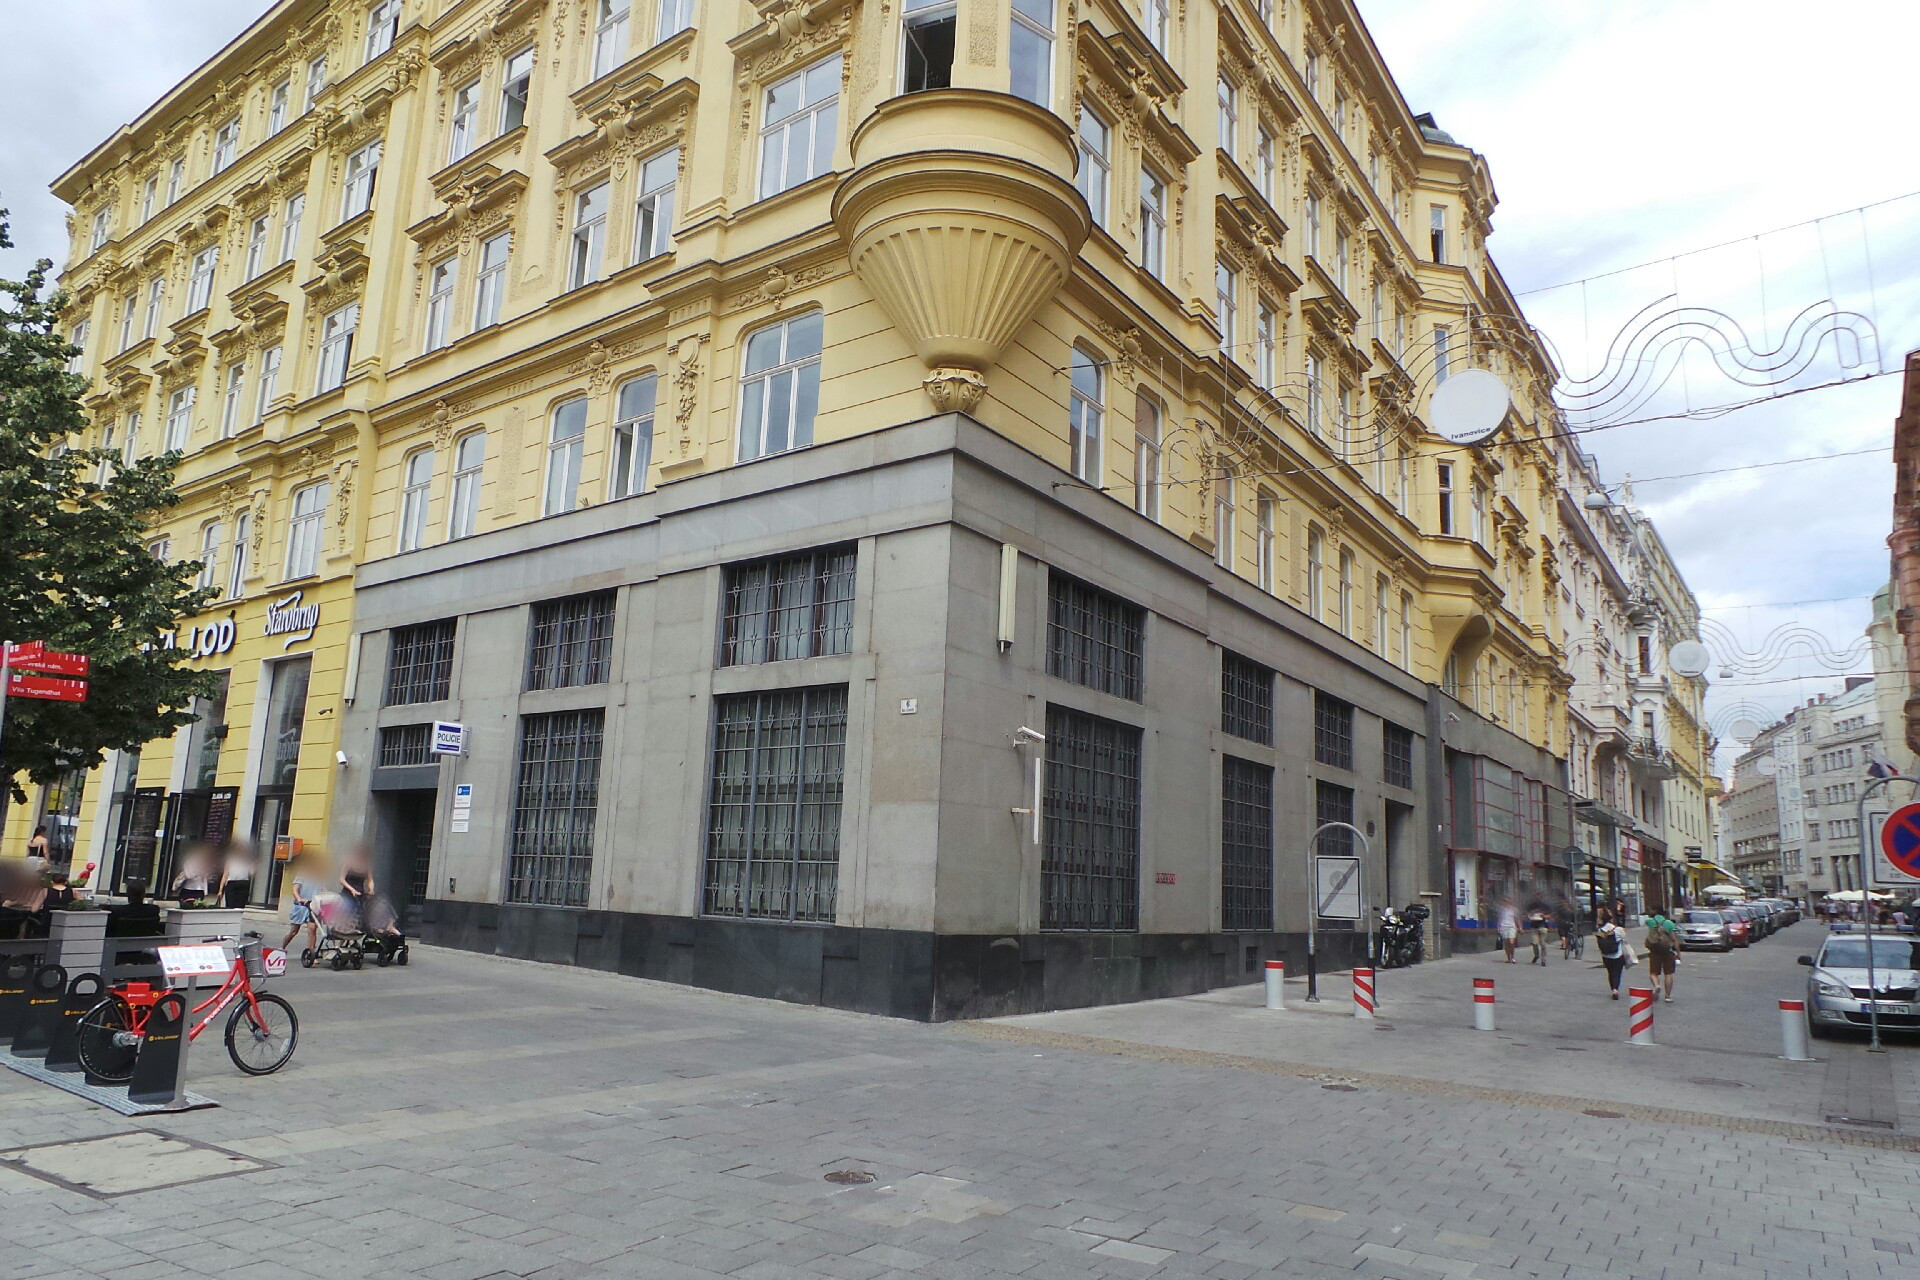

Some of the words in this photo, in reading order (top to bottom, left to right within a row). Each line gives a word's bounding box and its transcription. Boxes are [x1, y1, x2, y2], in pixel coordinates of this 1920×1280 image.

[1451, 427, 1491, 440] Ivanovice
[264, 591, 320, 650] Starobrno
[27, 687, 61, 696] Tugendhat
[437, 732, 461, 744] POLICIE
